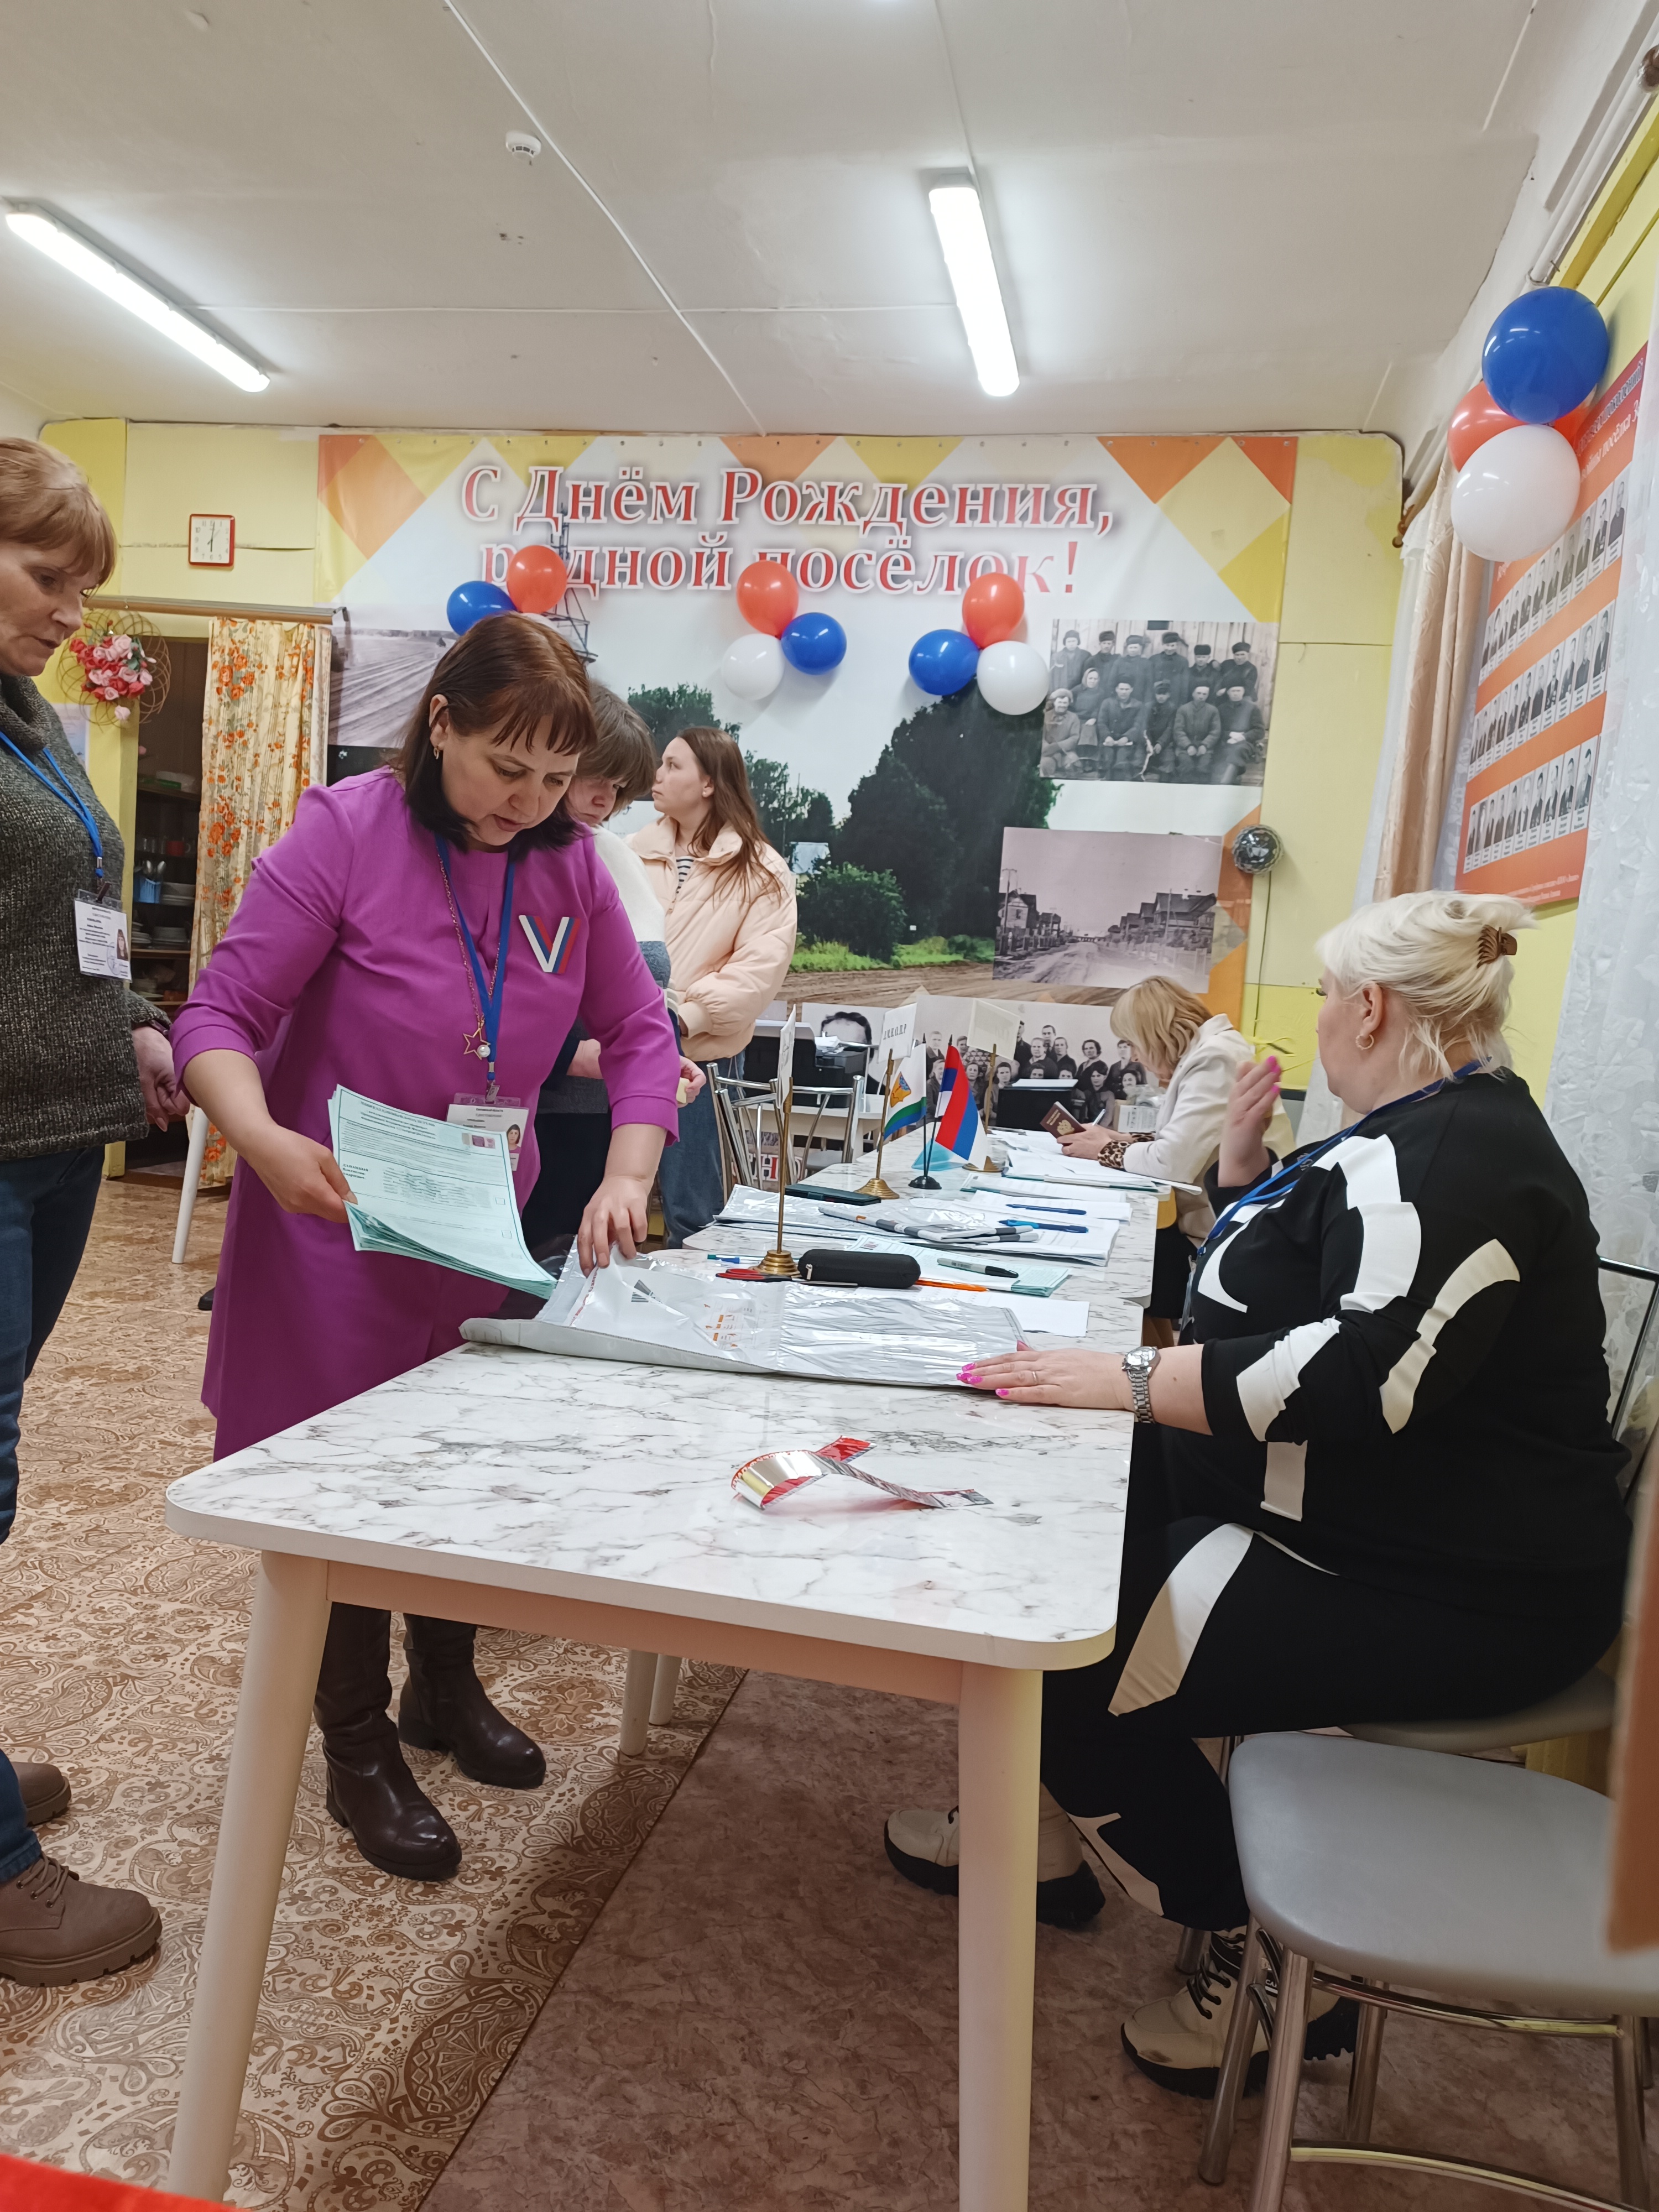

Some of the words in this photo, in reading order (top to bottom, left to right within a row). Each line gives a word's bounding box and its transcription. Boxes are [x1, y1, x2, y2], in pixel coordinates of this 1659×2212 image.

[462, 466, 501, 521] С
[513, 466, 699, 535] Днём
[718, 468, 1113, 538] Рождения,
[480, 531, 733, 600] рдной
